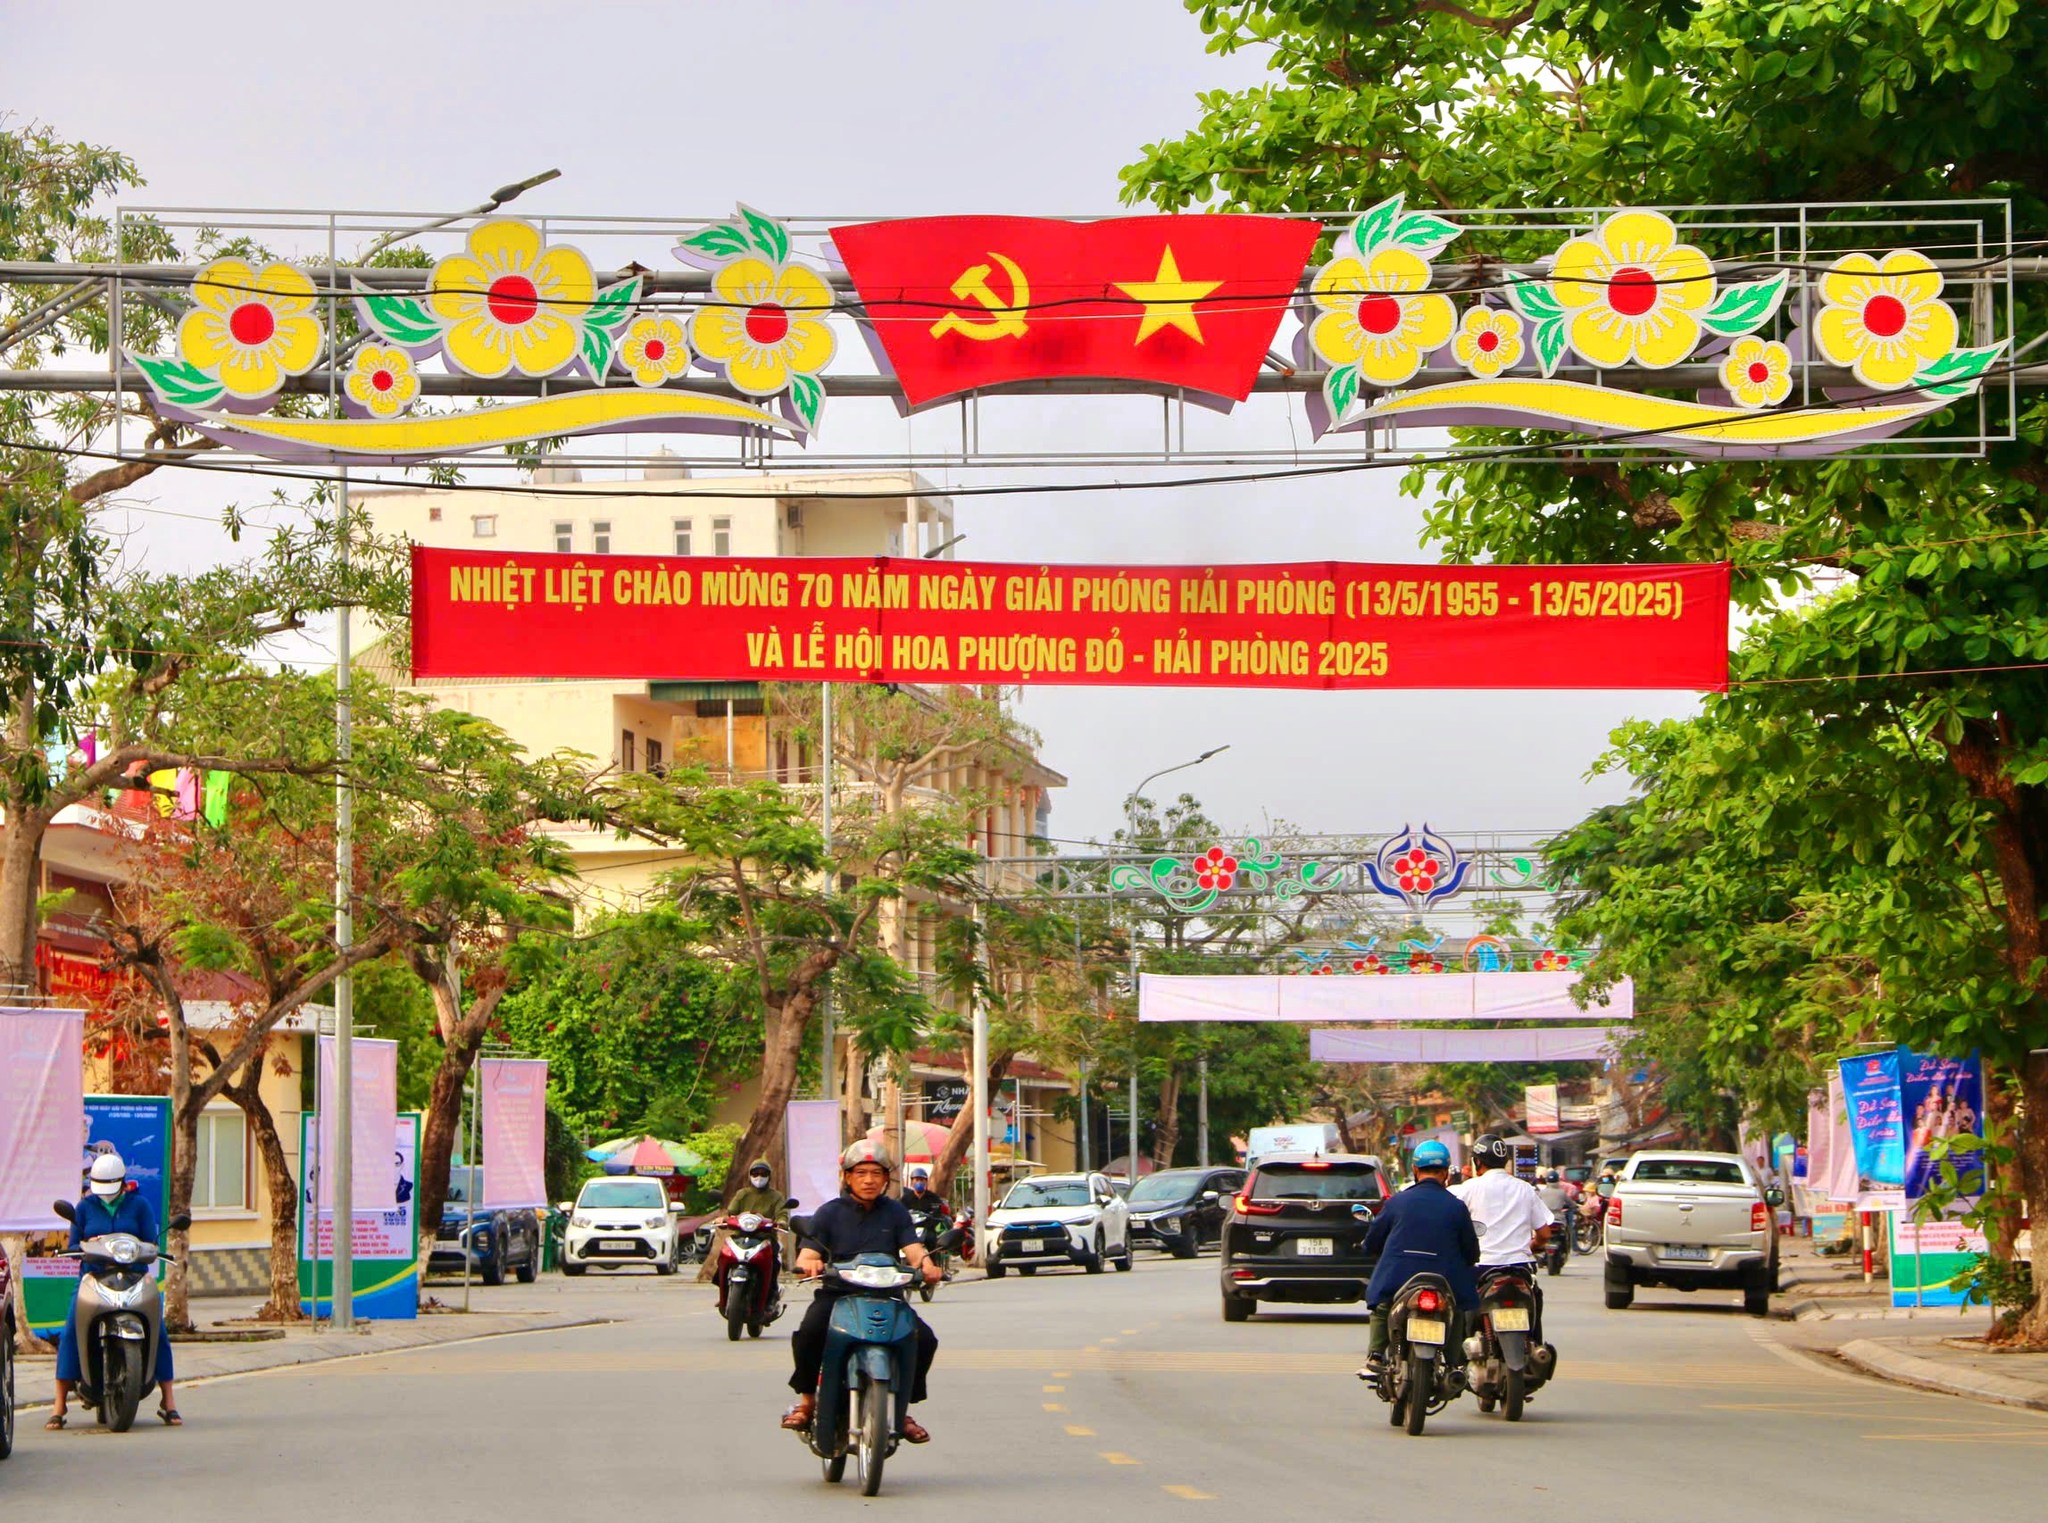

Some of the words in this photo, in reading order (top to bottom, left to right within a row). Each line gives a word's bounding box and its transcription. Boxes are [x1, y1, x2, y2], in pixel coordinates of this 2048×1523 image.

[450, 562, 536, 610] NHIỆT
[545, 562, 604, 611] LIỆT
[613, 563, 691, 606] CHÀO
[701, 564, 788, 607] MỪNG
[798, 573, 832, 608] 70
[843, 566, 909, 609] NĂM
[918, 568, 996, 611] NGÀY
[1006, 565, 1062, 612] GIẢI
[1072, 571, 1170, 614] PHÓNG
[1180, 568, 1228, 614] HẢI
[1237, 572, 1336, 615] PHÒNG
[1346, 581, 1498, 618] (13/5/1955
[1529, 581, 1683, 620] 13/5/2025)
[747, 624, 784, 668] VÀ
[792, 621, 826, 669] LỄ
[834, 627, 883, 677] HỘI
[892, 635, 949, 671] HOA
[958, 633, 1077, 679] PHƯỢNG
[1085, 627, 1124, 674] ĐỎ
[1133, 654, 1144, 662] -
[1153, 627, 1201, 674] HẢI
[1210, 631, 1309, 676] PHÒNG
[1318, 641, 1389, 677] 2025
